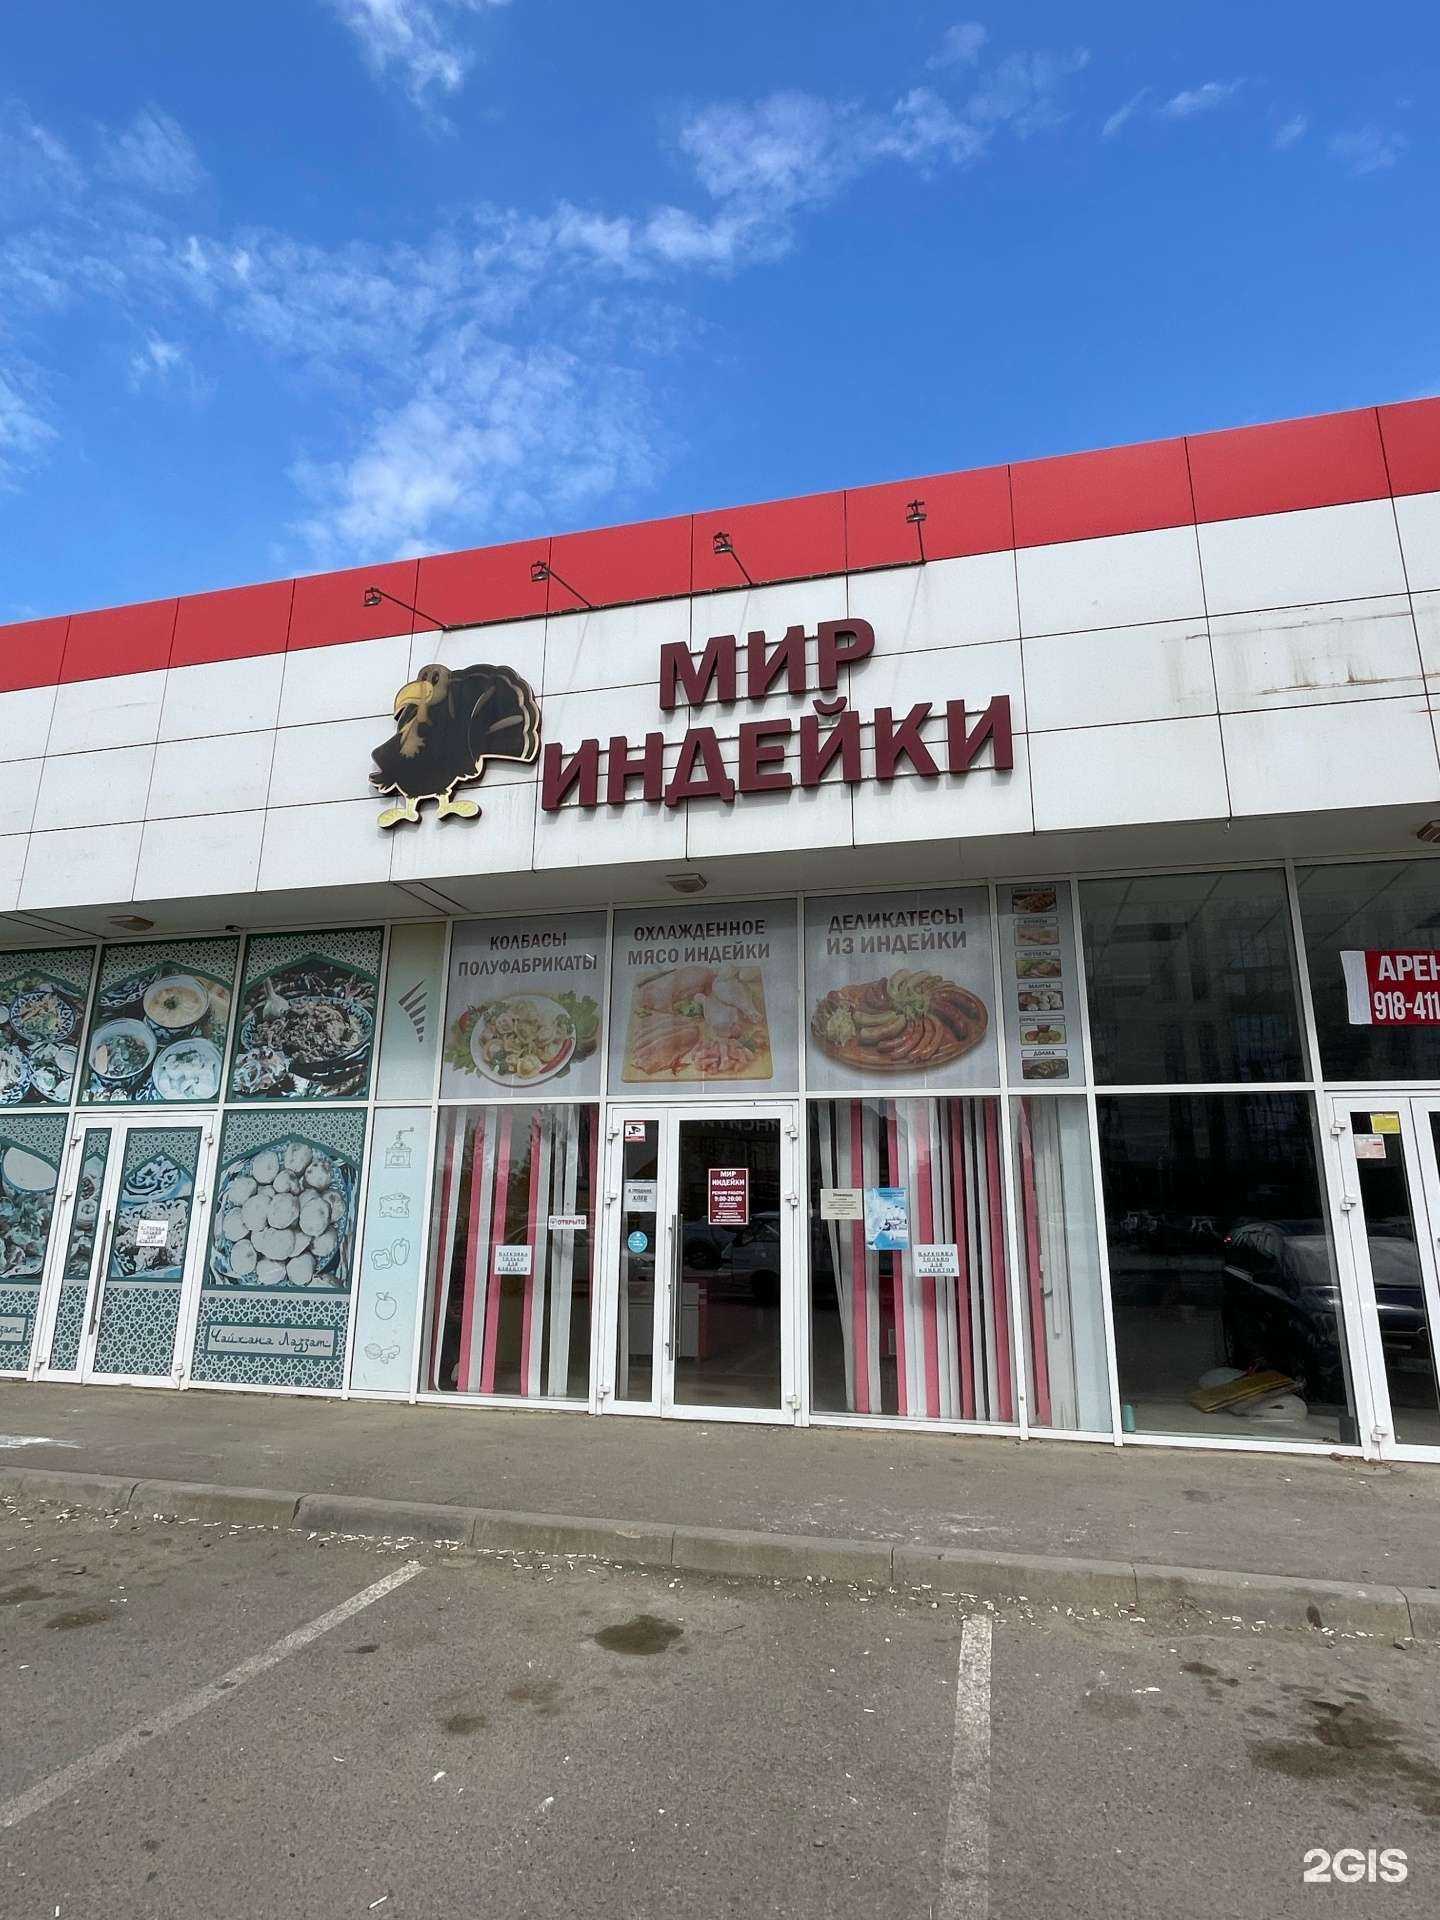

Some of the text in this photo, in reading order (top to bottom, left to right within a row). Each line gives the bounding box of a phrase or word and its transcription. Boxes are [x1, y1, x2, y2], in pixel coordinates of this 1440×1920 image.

[659, 617, 875, 711] МИР
[541, 695, 1013, 811] ИНДЕЙКИ
[634, 919, 765, 942] ОХЛАЖДЕННОЕ
[829, 907, 964, 934] ДЕЛИКАТЕСЫ
[490, 931, 567, 951] КОЛБАСЫ
[827, 928, 967, 956] ИЗ ИНДЕЙКИ
[458, 954, 597, 977] ПОЛУФАБРИКАТЫ
[628, 941, 770, 966] МЯСО ИНДЕЙКИ
[712, 1178, 744, 1186] ИНДЕЙКИ
[557, 1218, 585, 1226] ОТКРЫТО
[211, 1329, 331, 1353] Чайхана Лаззат
